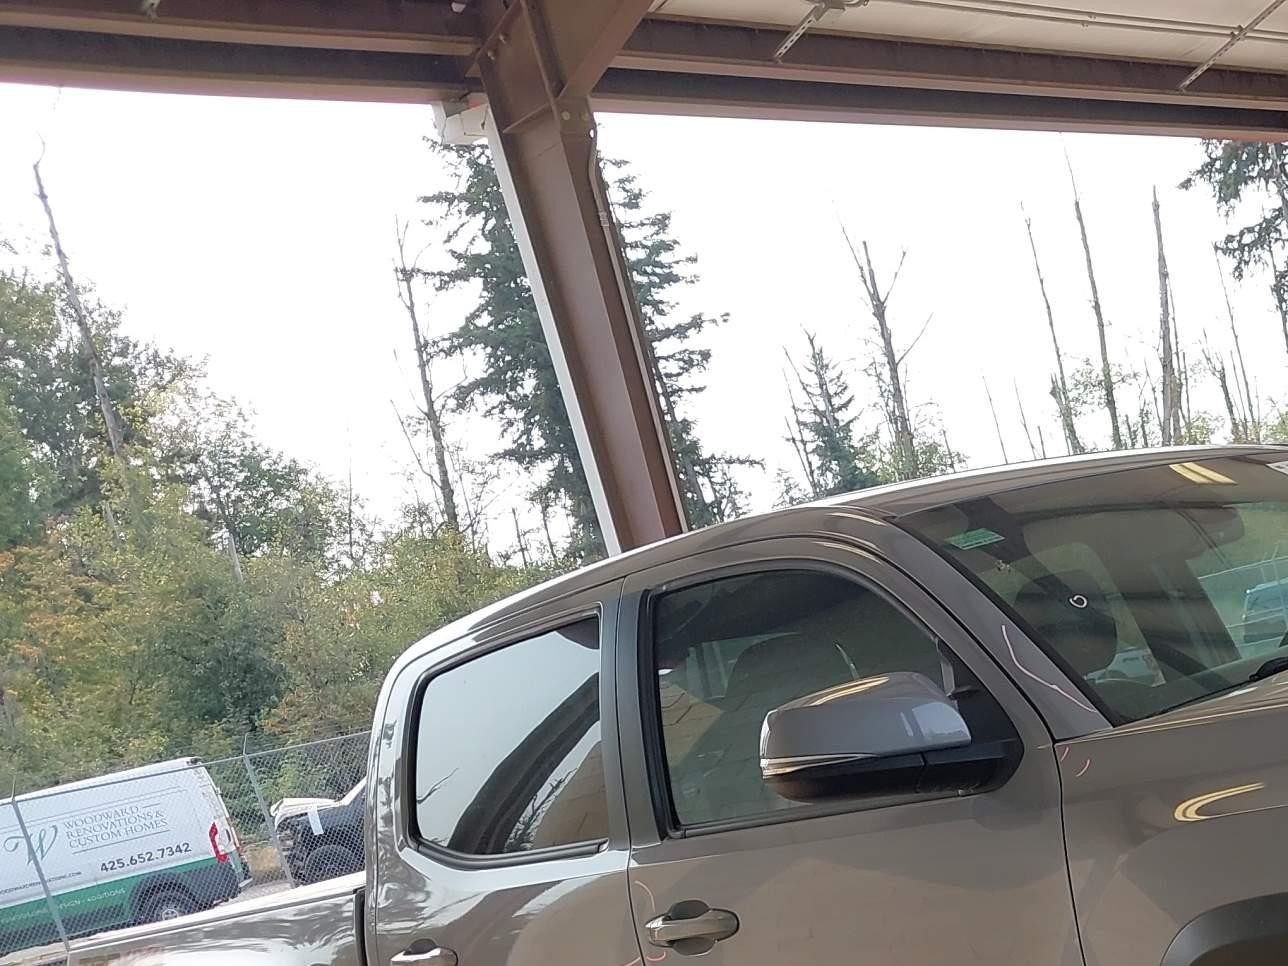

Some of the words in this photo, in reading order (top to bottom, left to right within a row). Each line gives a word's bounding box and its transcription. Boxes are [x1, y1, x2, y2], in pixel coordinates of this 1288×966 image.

[63, 806, 139, 829] WOODWARD
[66, 811, 153, 839] RENOVATIONS
[154, 808, 165, 818] &
[69, 830, 123, 849] CUSTOM
[125, 818, 168, 836] HOMES
[100, 842, 192, 873] 425.652.7342
